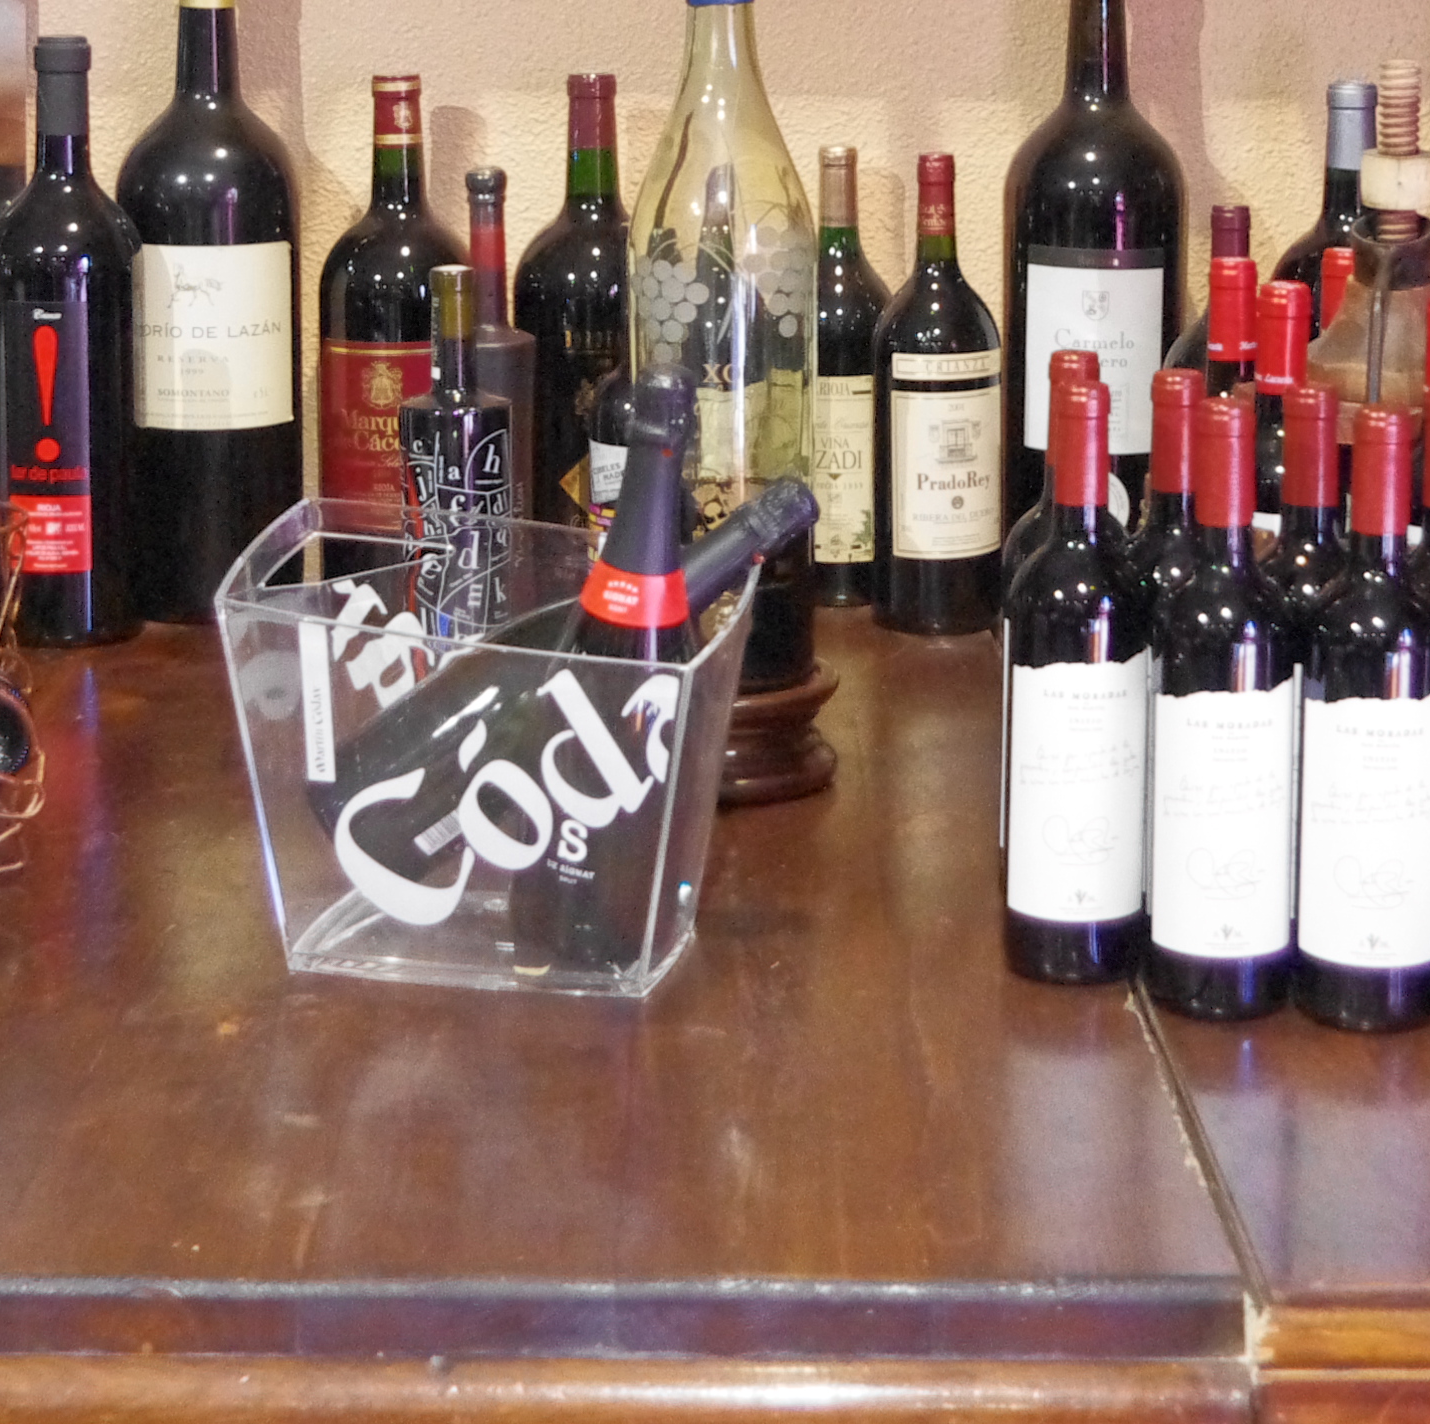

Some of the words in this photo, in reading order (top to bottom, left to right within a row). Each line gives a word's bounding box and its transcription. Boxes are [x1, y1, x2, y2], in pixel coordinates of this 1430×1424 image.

[191, 326, 219, 339] DE
[227, 319, 282, 339] LAZÁN
[1053, 327, 1135, 350] Carmelo
[1100, 357, 1128, 368] ero
[340, 407, 400, 436] Marqu
[820, 436, 850, 449] VIÑA
[815, 449, 863, 470] ZADI
[915, 469, 992, 491] PradoRey
